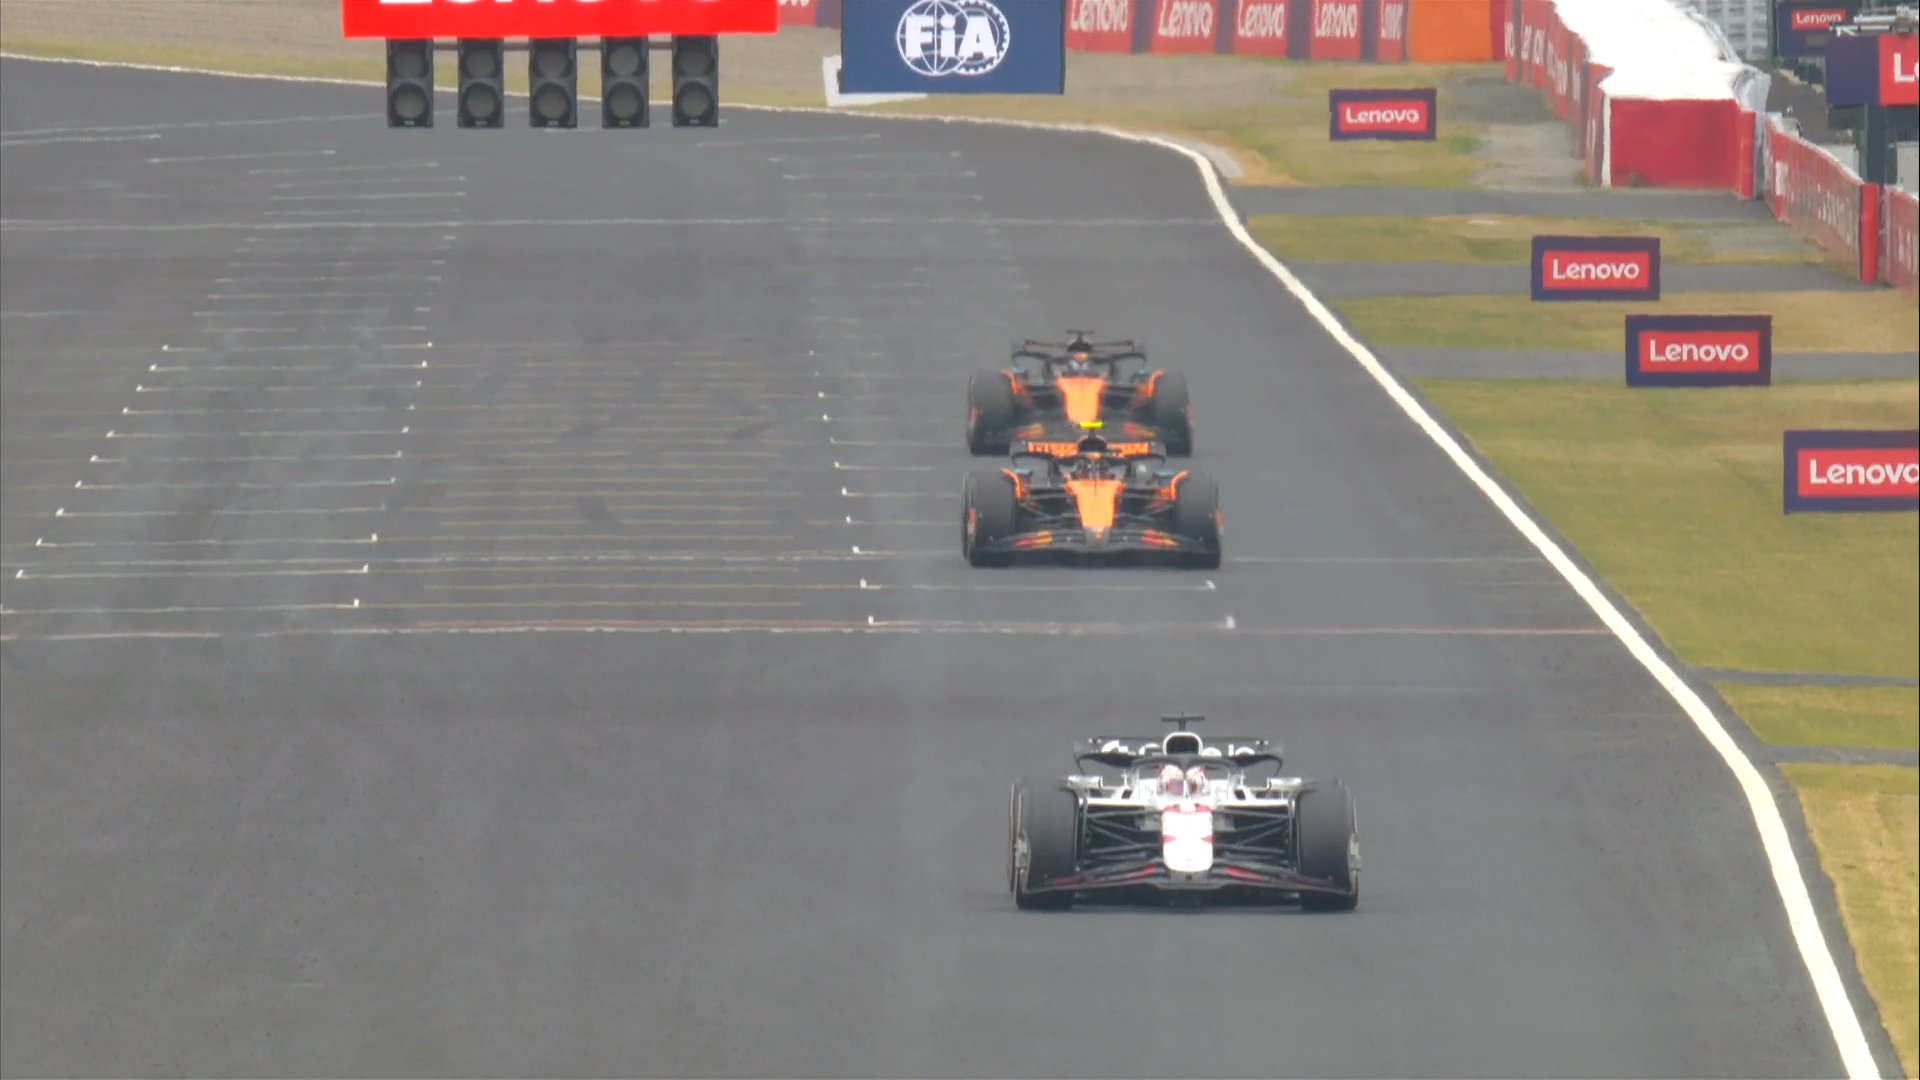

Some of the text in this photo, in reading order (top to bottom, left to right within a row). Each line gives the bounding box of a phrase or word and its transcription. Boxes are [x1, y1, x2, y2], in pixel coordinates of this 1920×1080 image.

[1346, 106, 1420, 124] Lenovo
[1552, 258, 1640, 280] Lenovo
[1649, 338, 1749, 362] Lenovo
